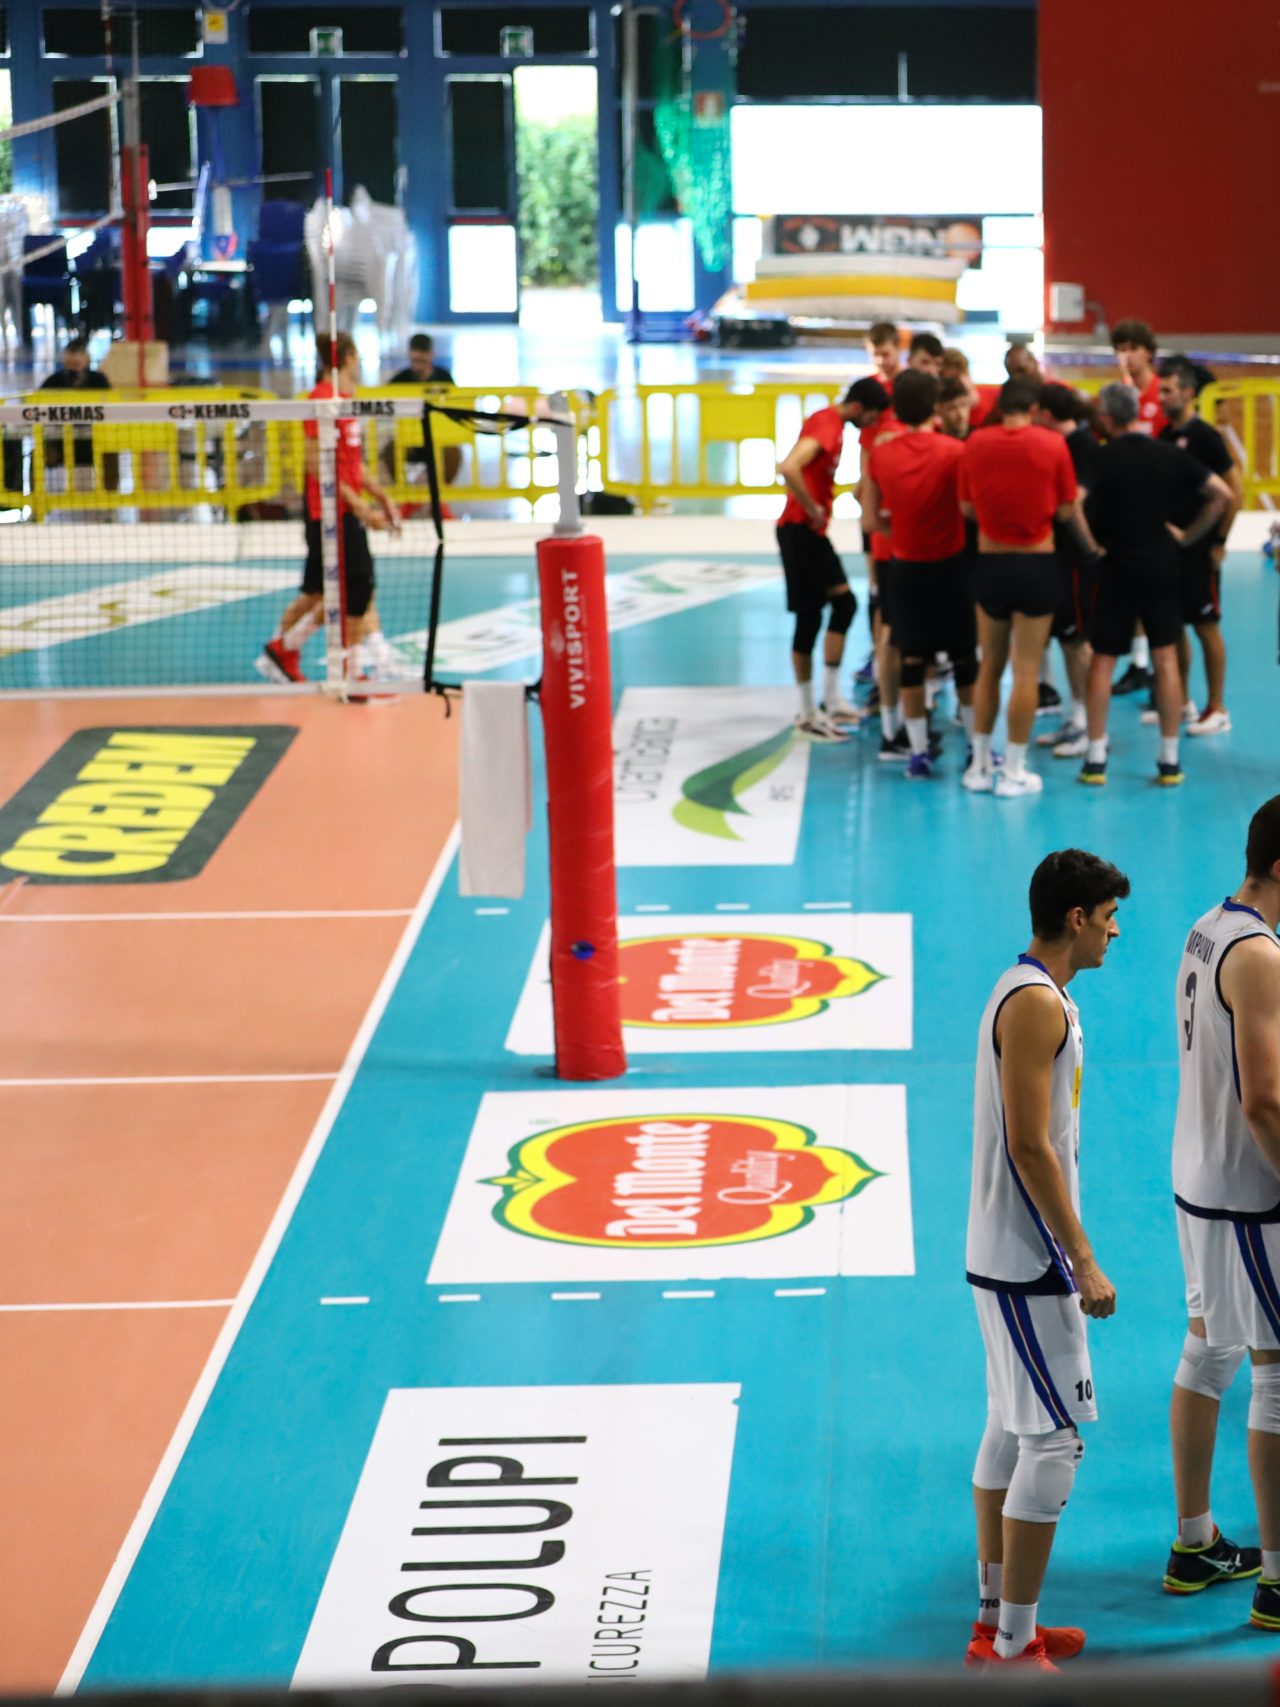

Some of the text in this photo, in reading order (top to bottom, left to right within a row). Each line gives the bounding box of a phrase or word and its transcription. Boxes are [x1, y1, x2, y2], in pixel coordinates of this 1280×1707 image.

[561, 567, 588, 710] VIVISPORT
[0, 731, 257, 877] CREDEM
[1184, 971, 1197, 1052] 3
[604, 1121, 713, 1237] Del Monte
[716, 1149, 796, 1205] Quality
[1075, 1379, 1093, 1402] 10
[588, 1569, 652, 1682] ICUREZZA
